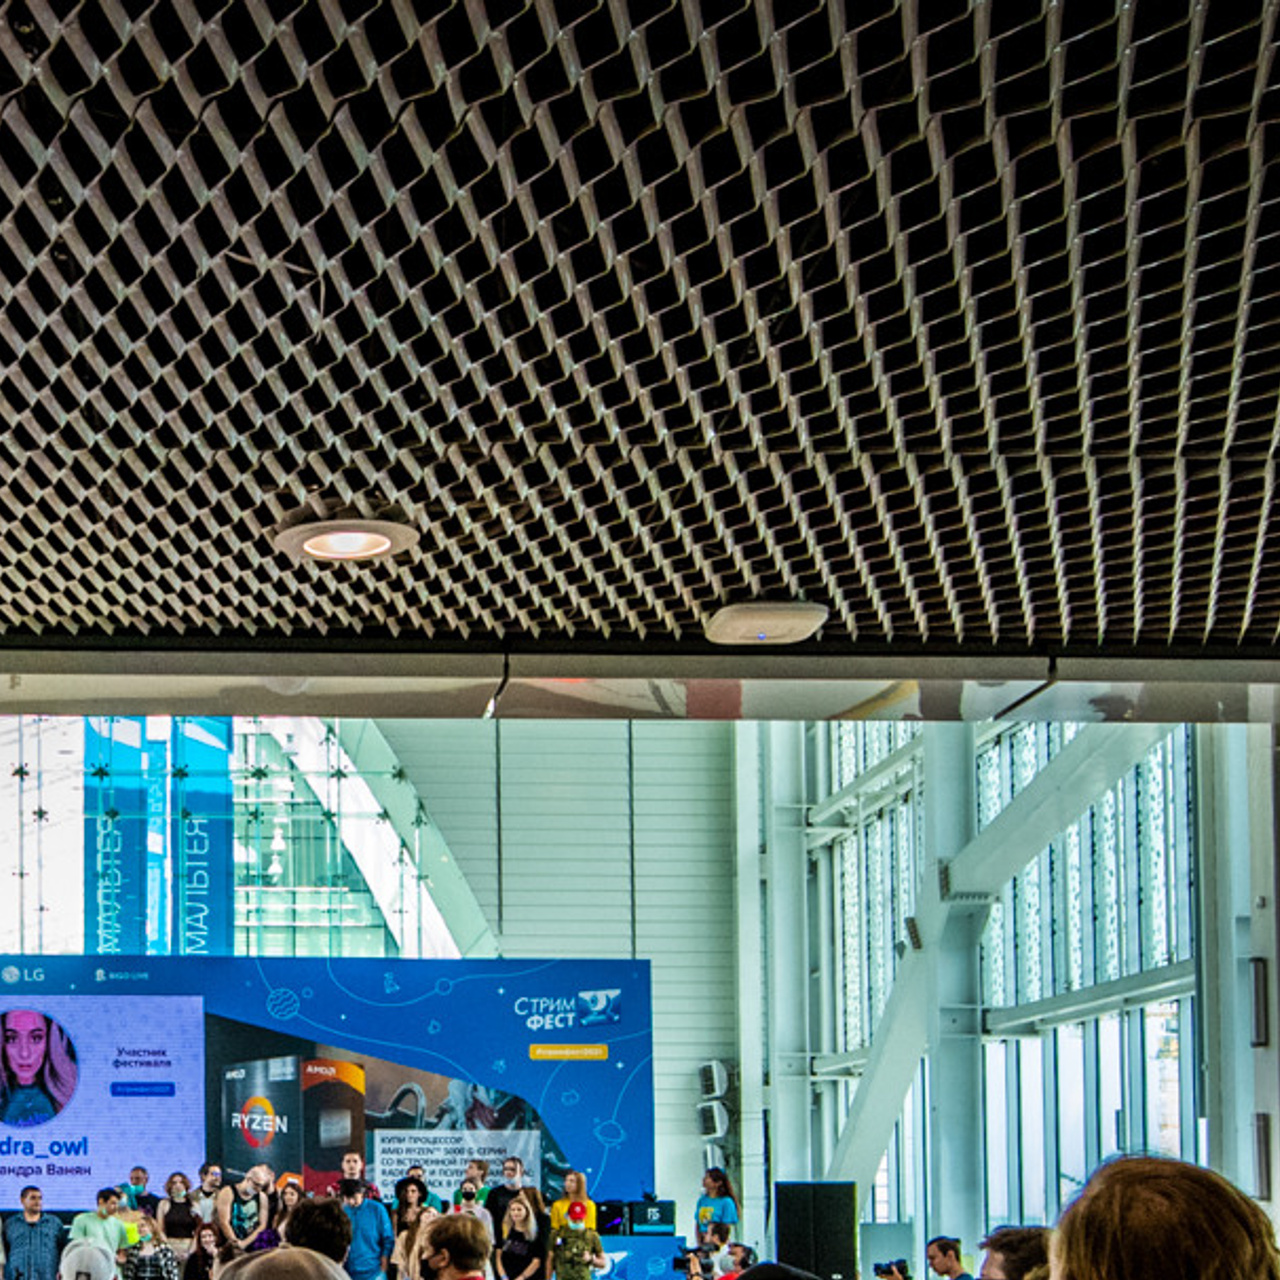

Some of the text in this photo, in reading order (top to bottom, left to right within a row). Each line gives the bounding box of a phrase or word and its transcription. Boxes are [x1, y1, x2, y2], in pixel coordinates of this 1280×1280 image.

[23, 968, 45, 982] LG
[514, 996, 576, 1015] СТРИМ
[526, 1012, 577, 1031] ФЕСТ
[116, 1047, 168, 1057] Участник
[112, 1059, 172, 1069] фестиваля
[231, 1113, 288, 1133] RYZEN
[46, 1164, 92, 1177] Ванян
